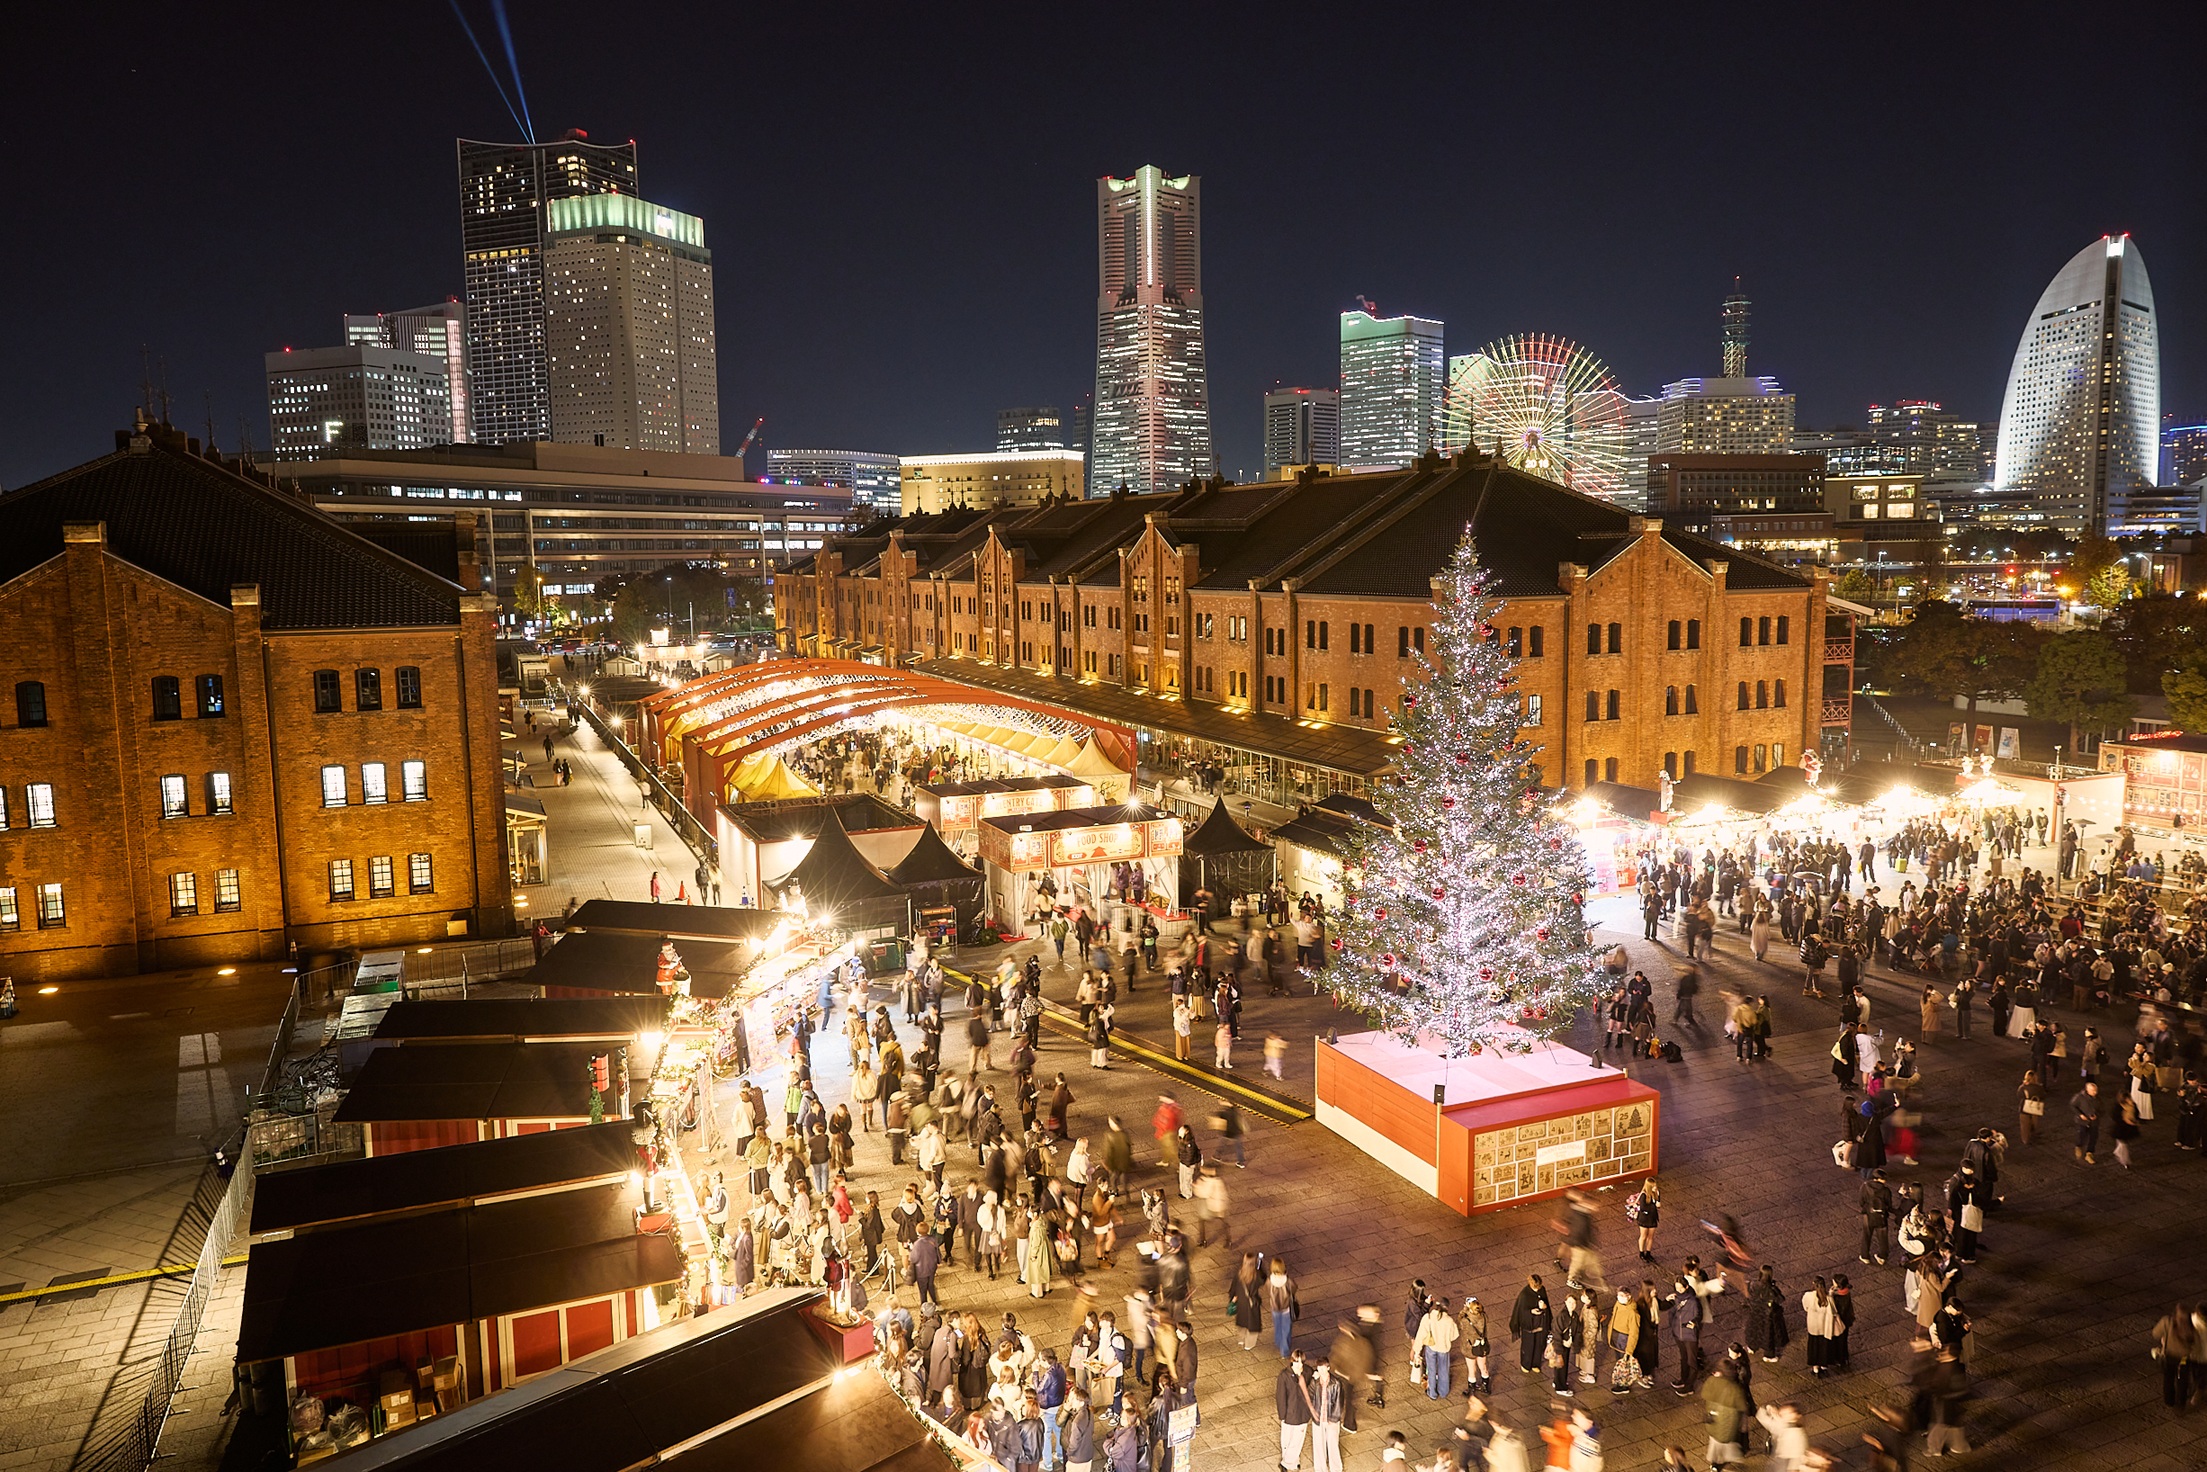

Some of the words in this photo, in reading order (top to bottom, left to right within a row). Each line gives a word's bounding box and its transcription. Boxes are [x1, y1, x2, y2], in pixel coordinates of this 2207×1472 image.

[325, 421, 343, 442] F
[1026, 797, 1043, 806] GATE
[1077, 834, 1096, 847] FOOD
[1099, 833, 1119, 843] SHOP
[1620, 1112, 1629, 1120] 25
